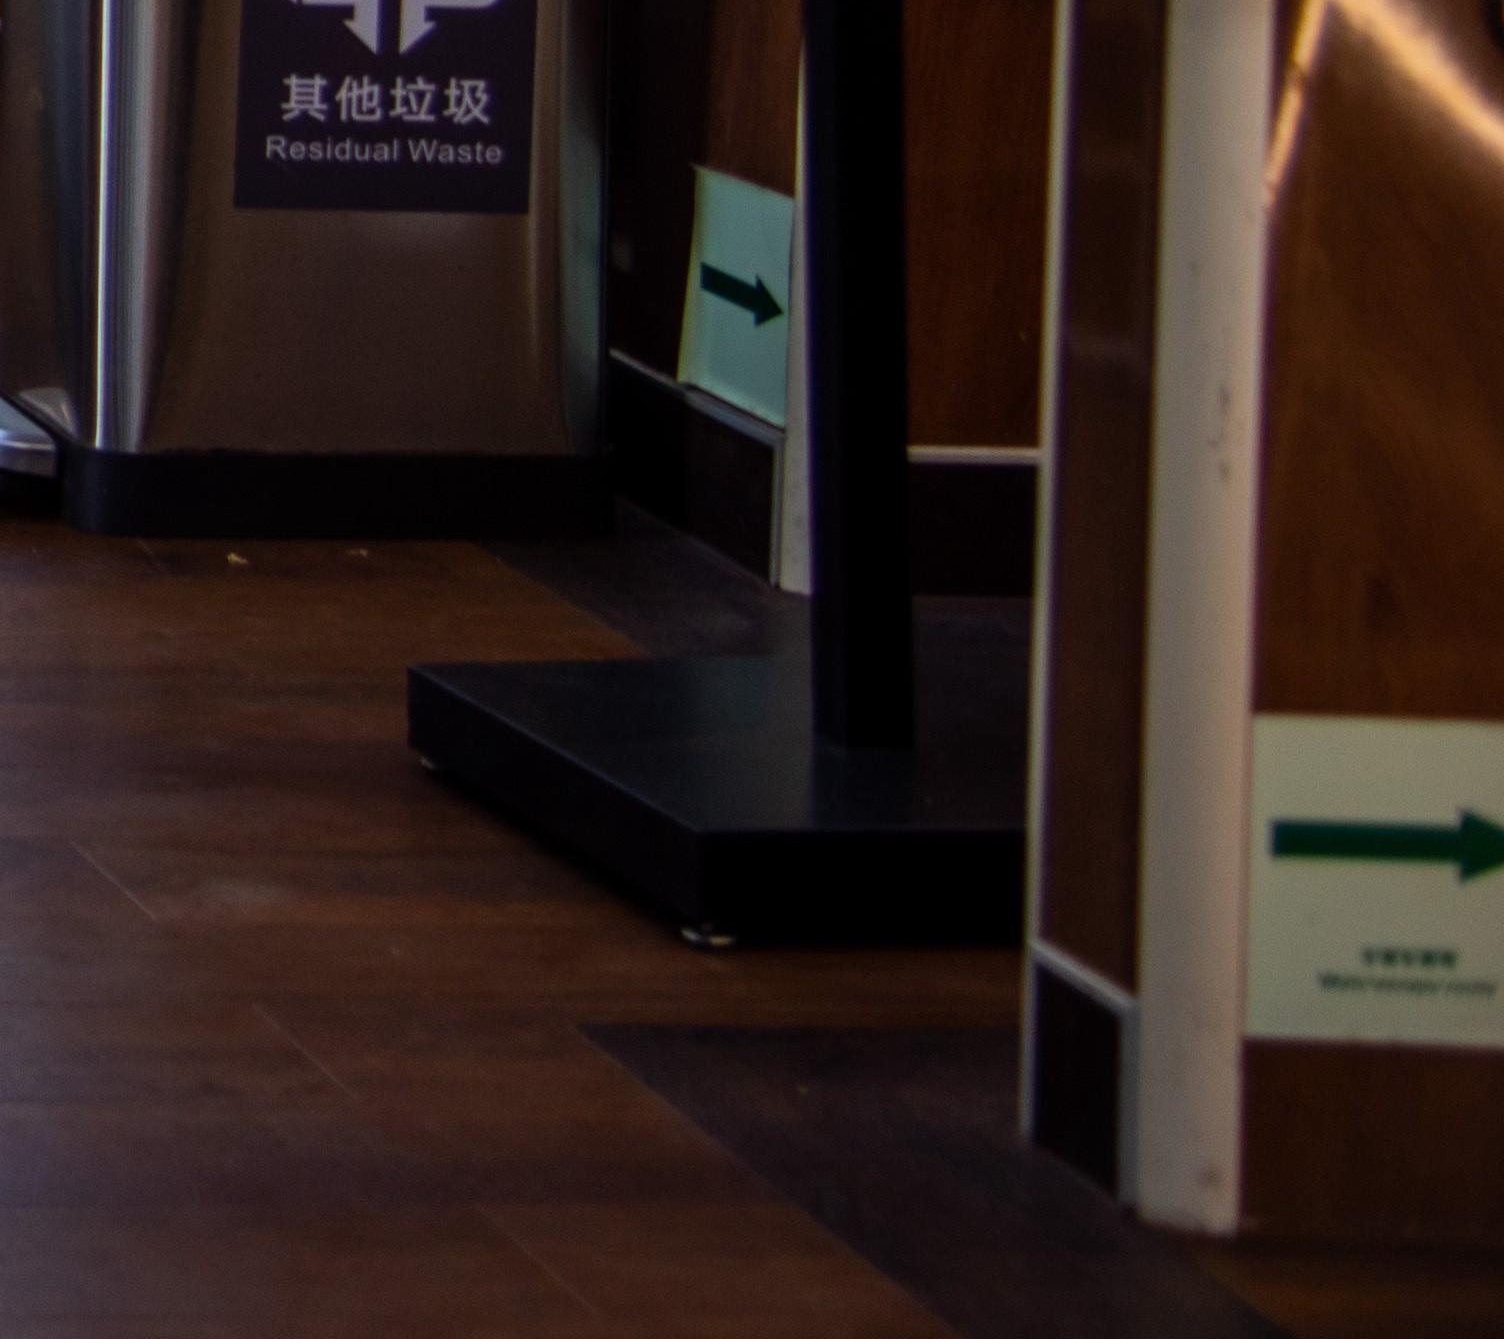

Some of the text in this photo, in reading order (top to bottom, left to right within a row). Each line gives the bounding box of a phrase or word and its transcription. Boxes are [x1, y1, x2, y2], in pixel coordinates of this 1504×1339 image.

[281, 74, 490, 124] 其他垃圾
[265, 135, 503, 164] Residual Waste
